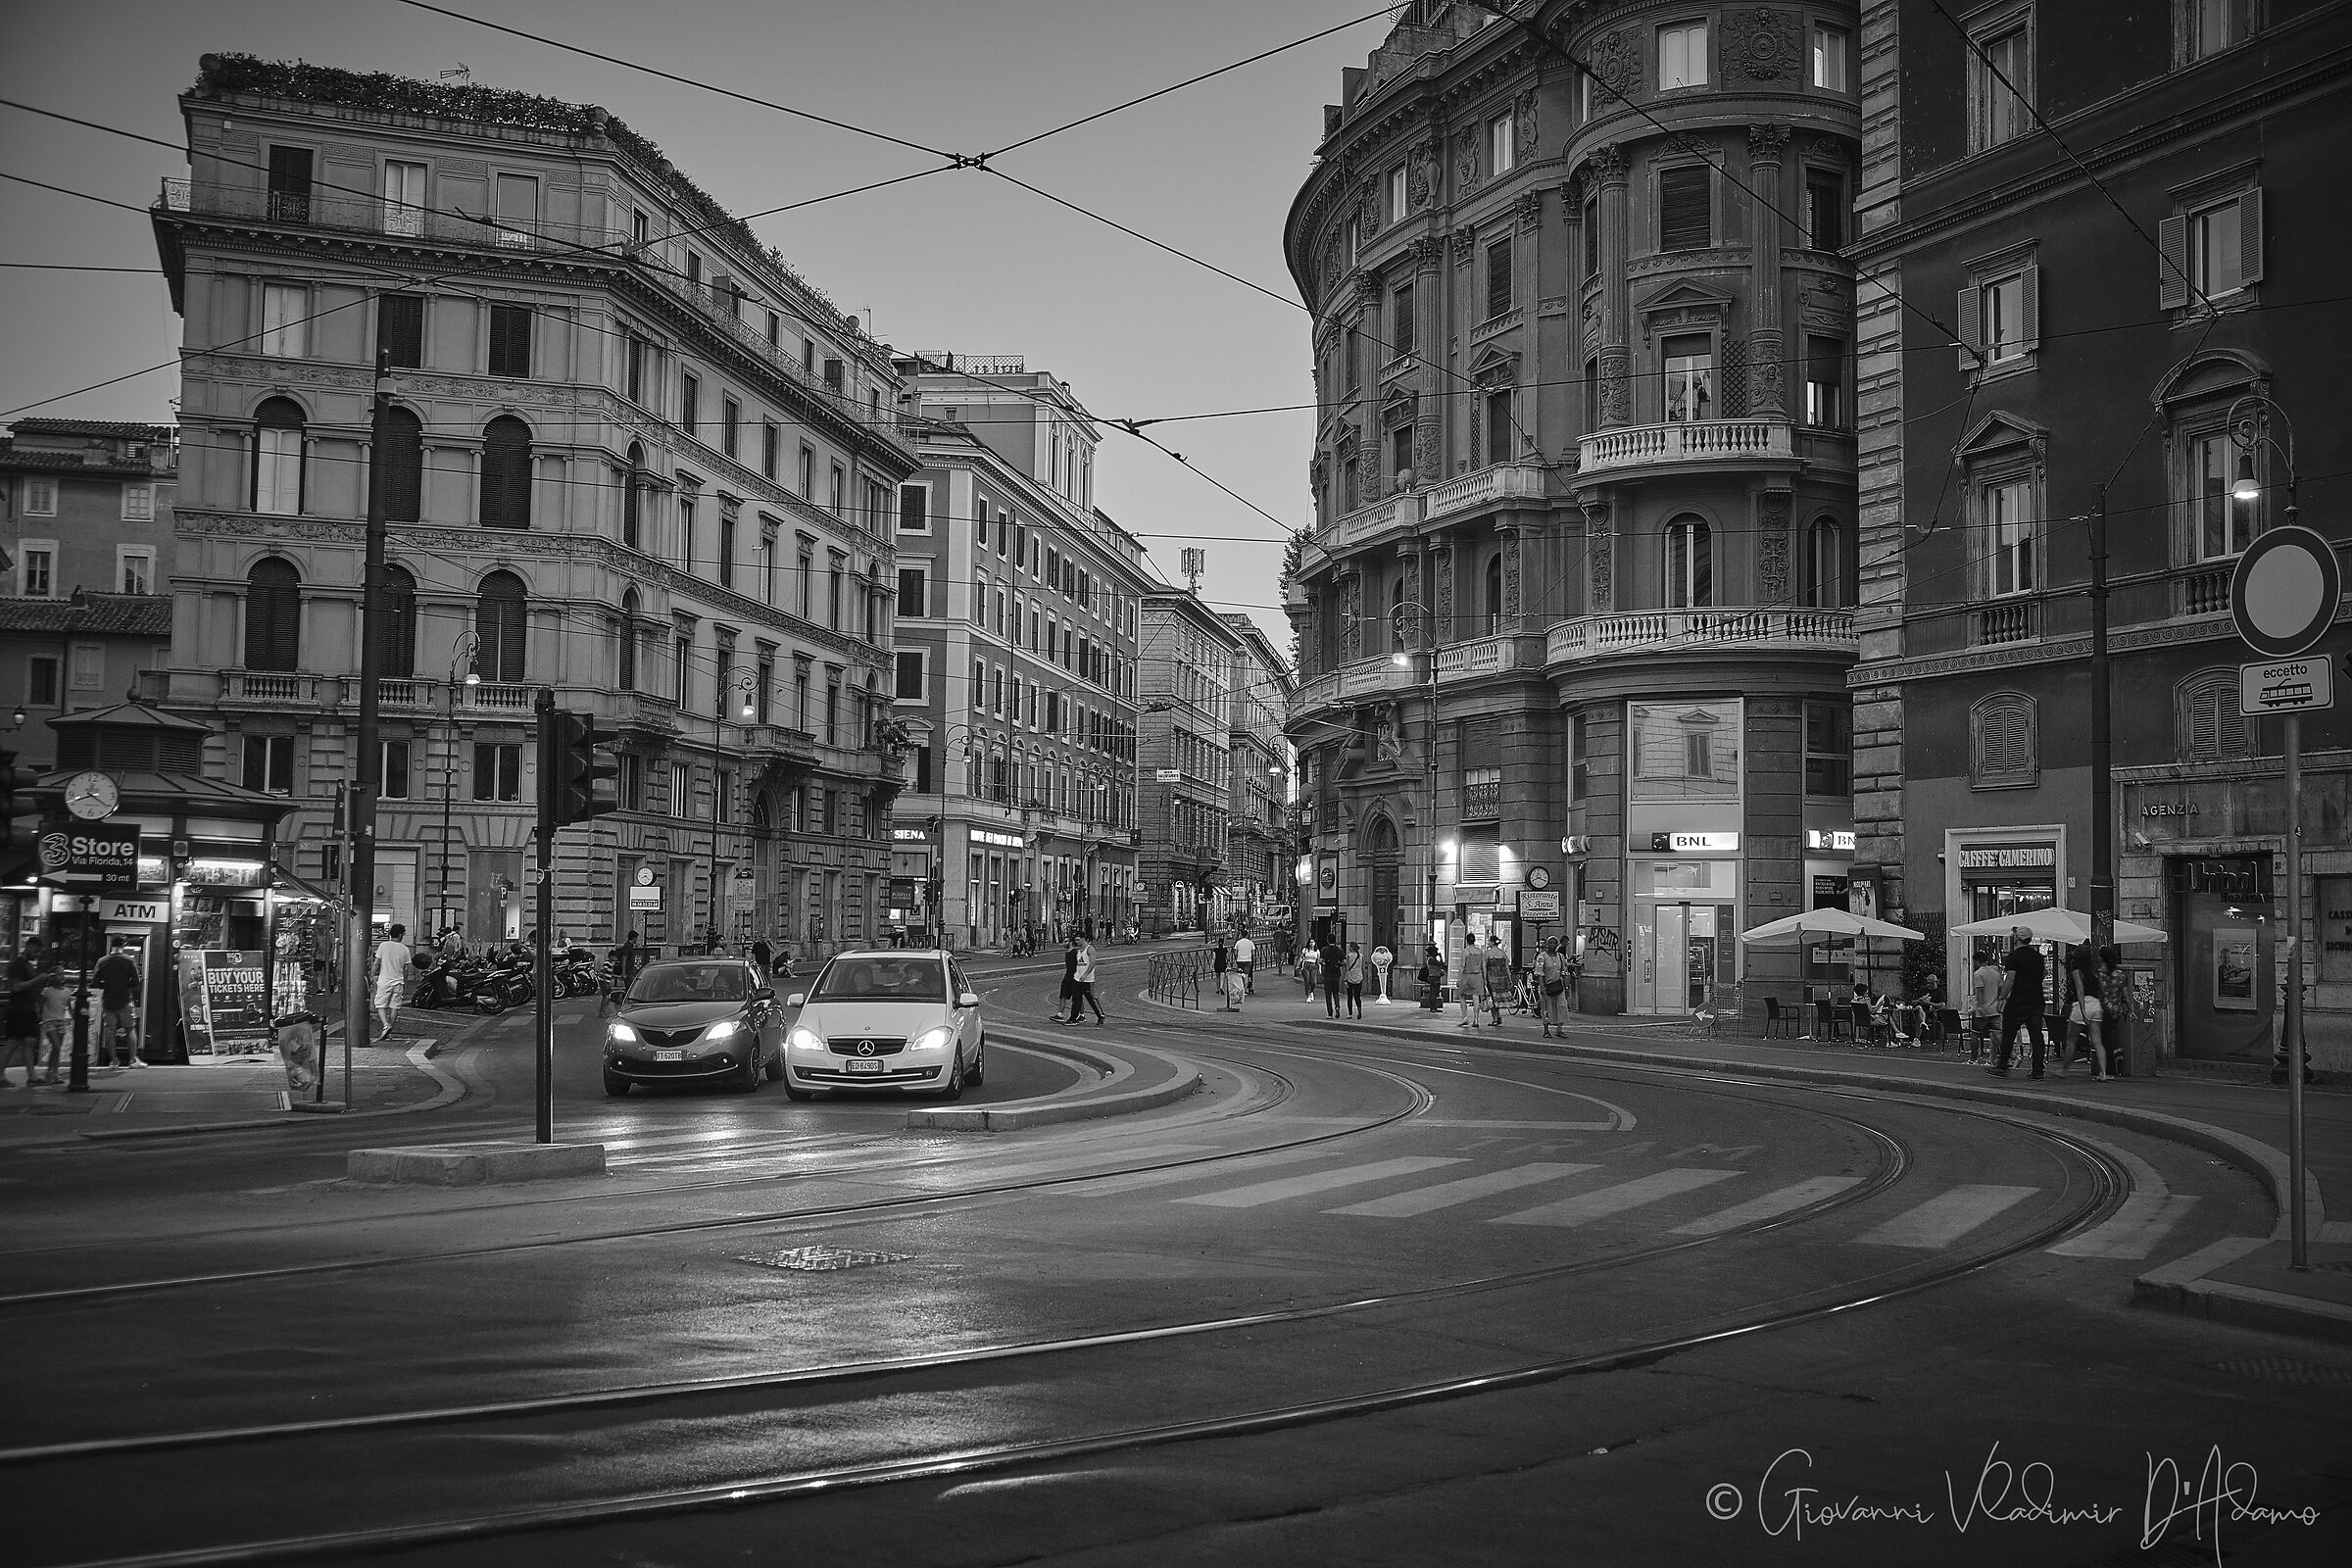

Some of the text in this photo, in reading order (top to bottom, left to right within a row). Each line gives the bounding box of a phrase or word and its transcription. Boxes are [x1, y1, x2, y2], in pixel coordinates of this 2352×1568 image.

[2263, 663, 2308, 679] eccetto
[87, 773, 99, 782] 12
[2142, 804, 2199, 816] AGENZIA
[894, 829, 926, 840] SIENA
[1838, 835, 1856, 846] BN
[72, 836, 135, 857] Store
[1677, 836, 1712, 847] BNL
[72, 857, 87, 865] Via
[1999, 848, 2055, 866] CAMERINO
[106, 873, 117, 882] 30
[2187, 860, 2259, 894] Unipol
[501, 887, 507, 899] P
[113, 904, 157, 919] ATM
[207, 971, 264, 984] BUY YOUR
[208, 983, 266, 994] TICKETS HERE
